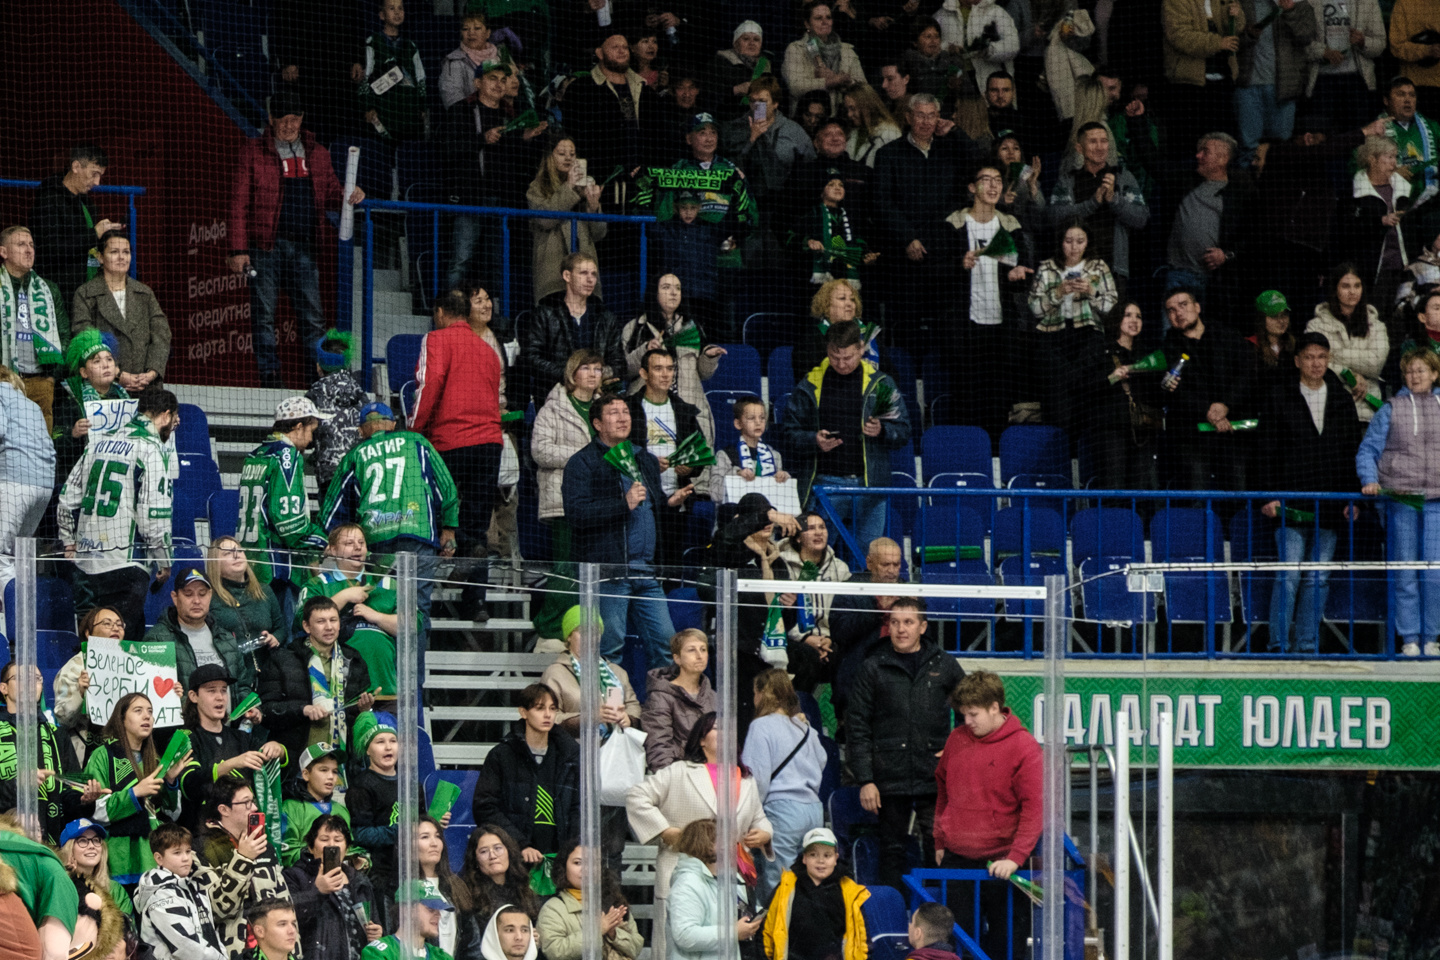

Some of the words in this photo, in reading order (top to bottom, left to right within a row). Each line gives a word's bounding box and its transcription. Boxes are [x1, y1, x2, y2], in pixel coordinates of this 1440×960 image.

[188, 218, 227, 245] Альфа
[188, 273, 250, 299] Бесплат
[188, 337, 226, 364] карта
[358, 437, 406, 462] ТАГИР
[81, 458, 130, 518] 45
[365, 455, 406, 505] 27
[279, 495, 301, 516] 33
[1242, 695, 1392, 750] ЮЛАЕВ
